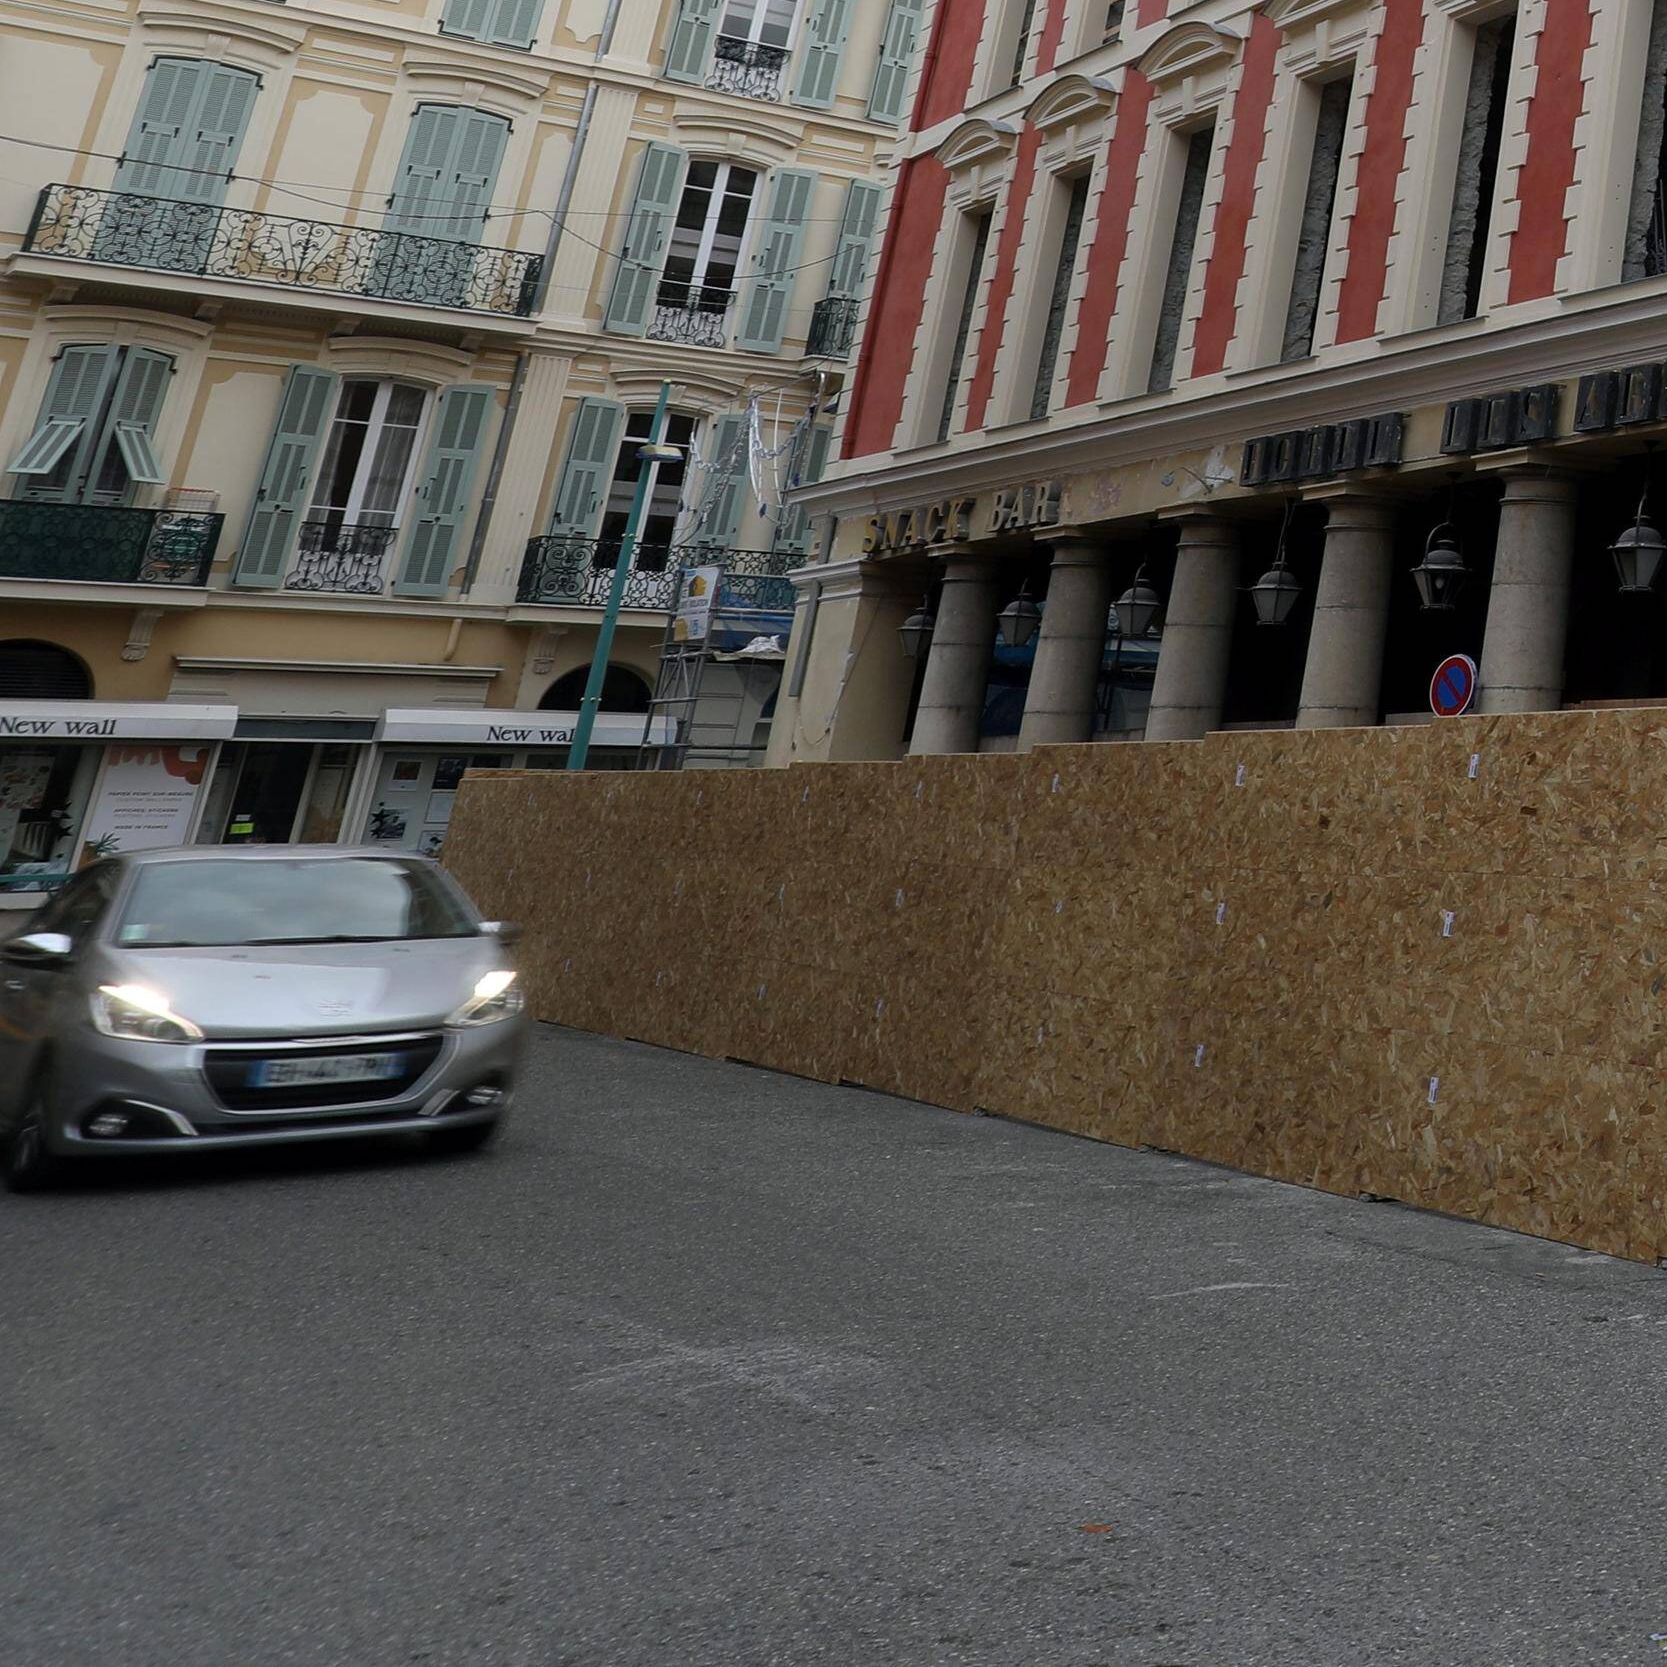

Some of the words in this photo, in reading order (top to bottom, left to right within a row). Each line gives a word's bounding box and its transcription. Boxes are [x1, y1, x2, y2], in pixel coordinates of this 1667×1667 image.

[862, 497, 974, 553] SNACK
[985, 481, 1058, 533] BAR
[0, 717, 56, 734] New
[65, 719, 117, 735] wall
[486, 726, 532, 742] New
[539, 728, 576, 743] wal
